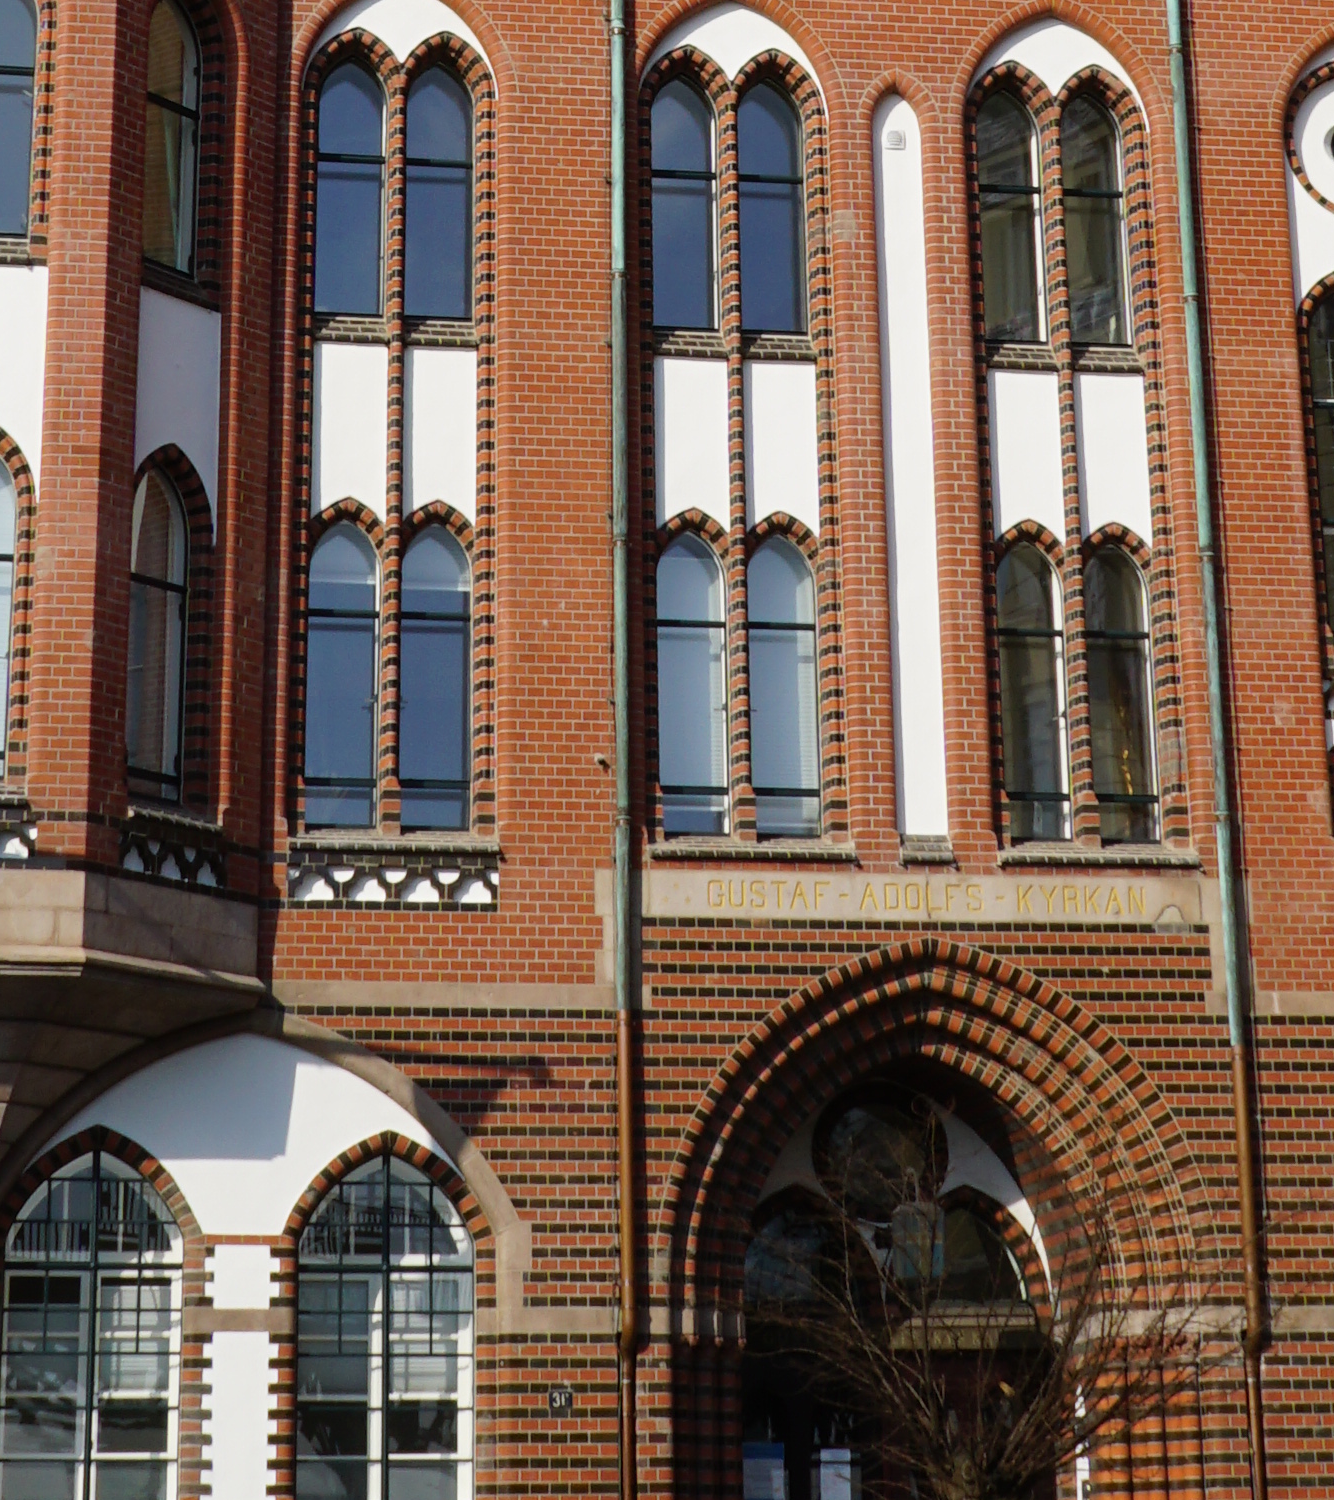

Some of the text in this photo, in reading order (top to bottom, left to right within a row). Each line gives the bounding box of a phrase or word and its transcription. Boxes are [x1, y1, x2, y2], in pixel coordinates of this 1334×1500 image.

[707, 879, 831, 910] GUSTAF
[859, 882, 985, 912] ADOLFS
[1016, 884, 1146, 915] KYRKAN
